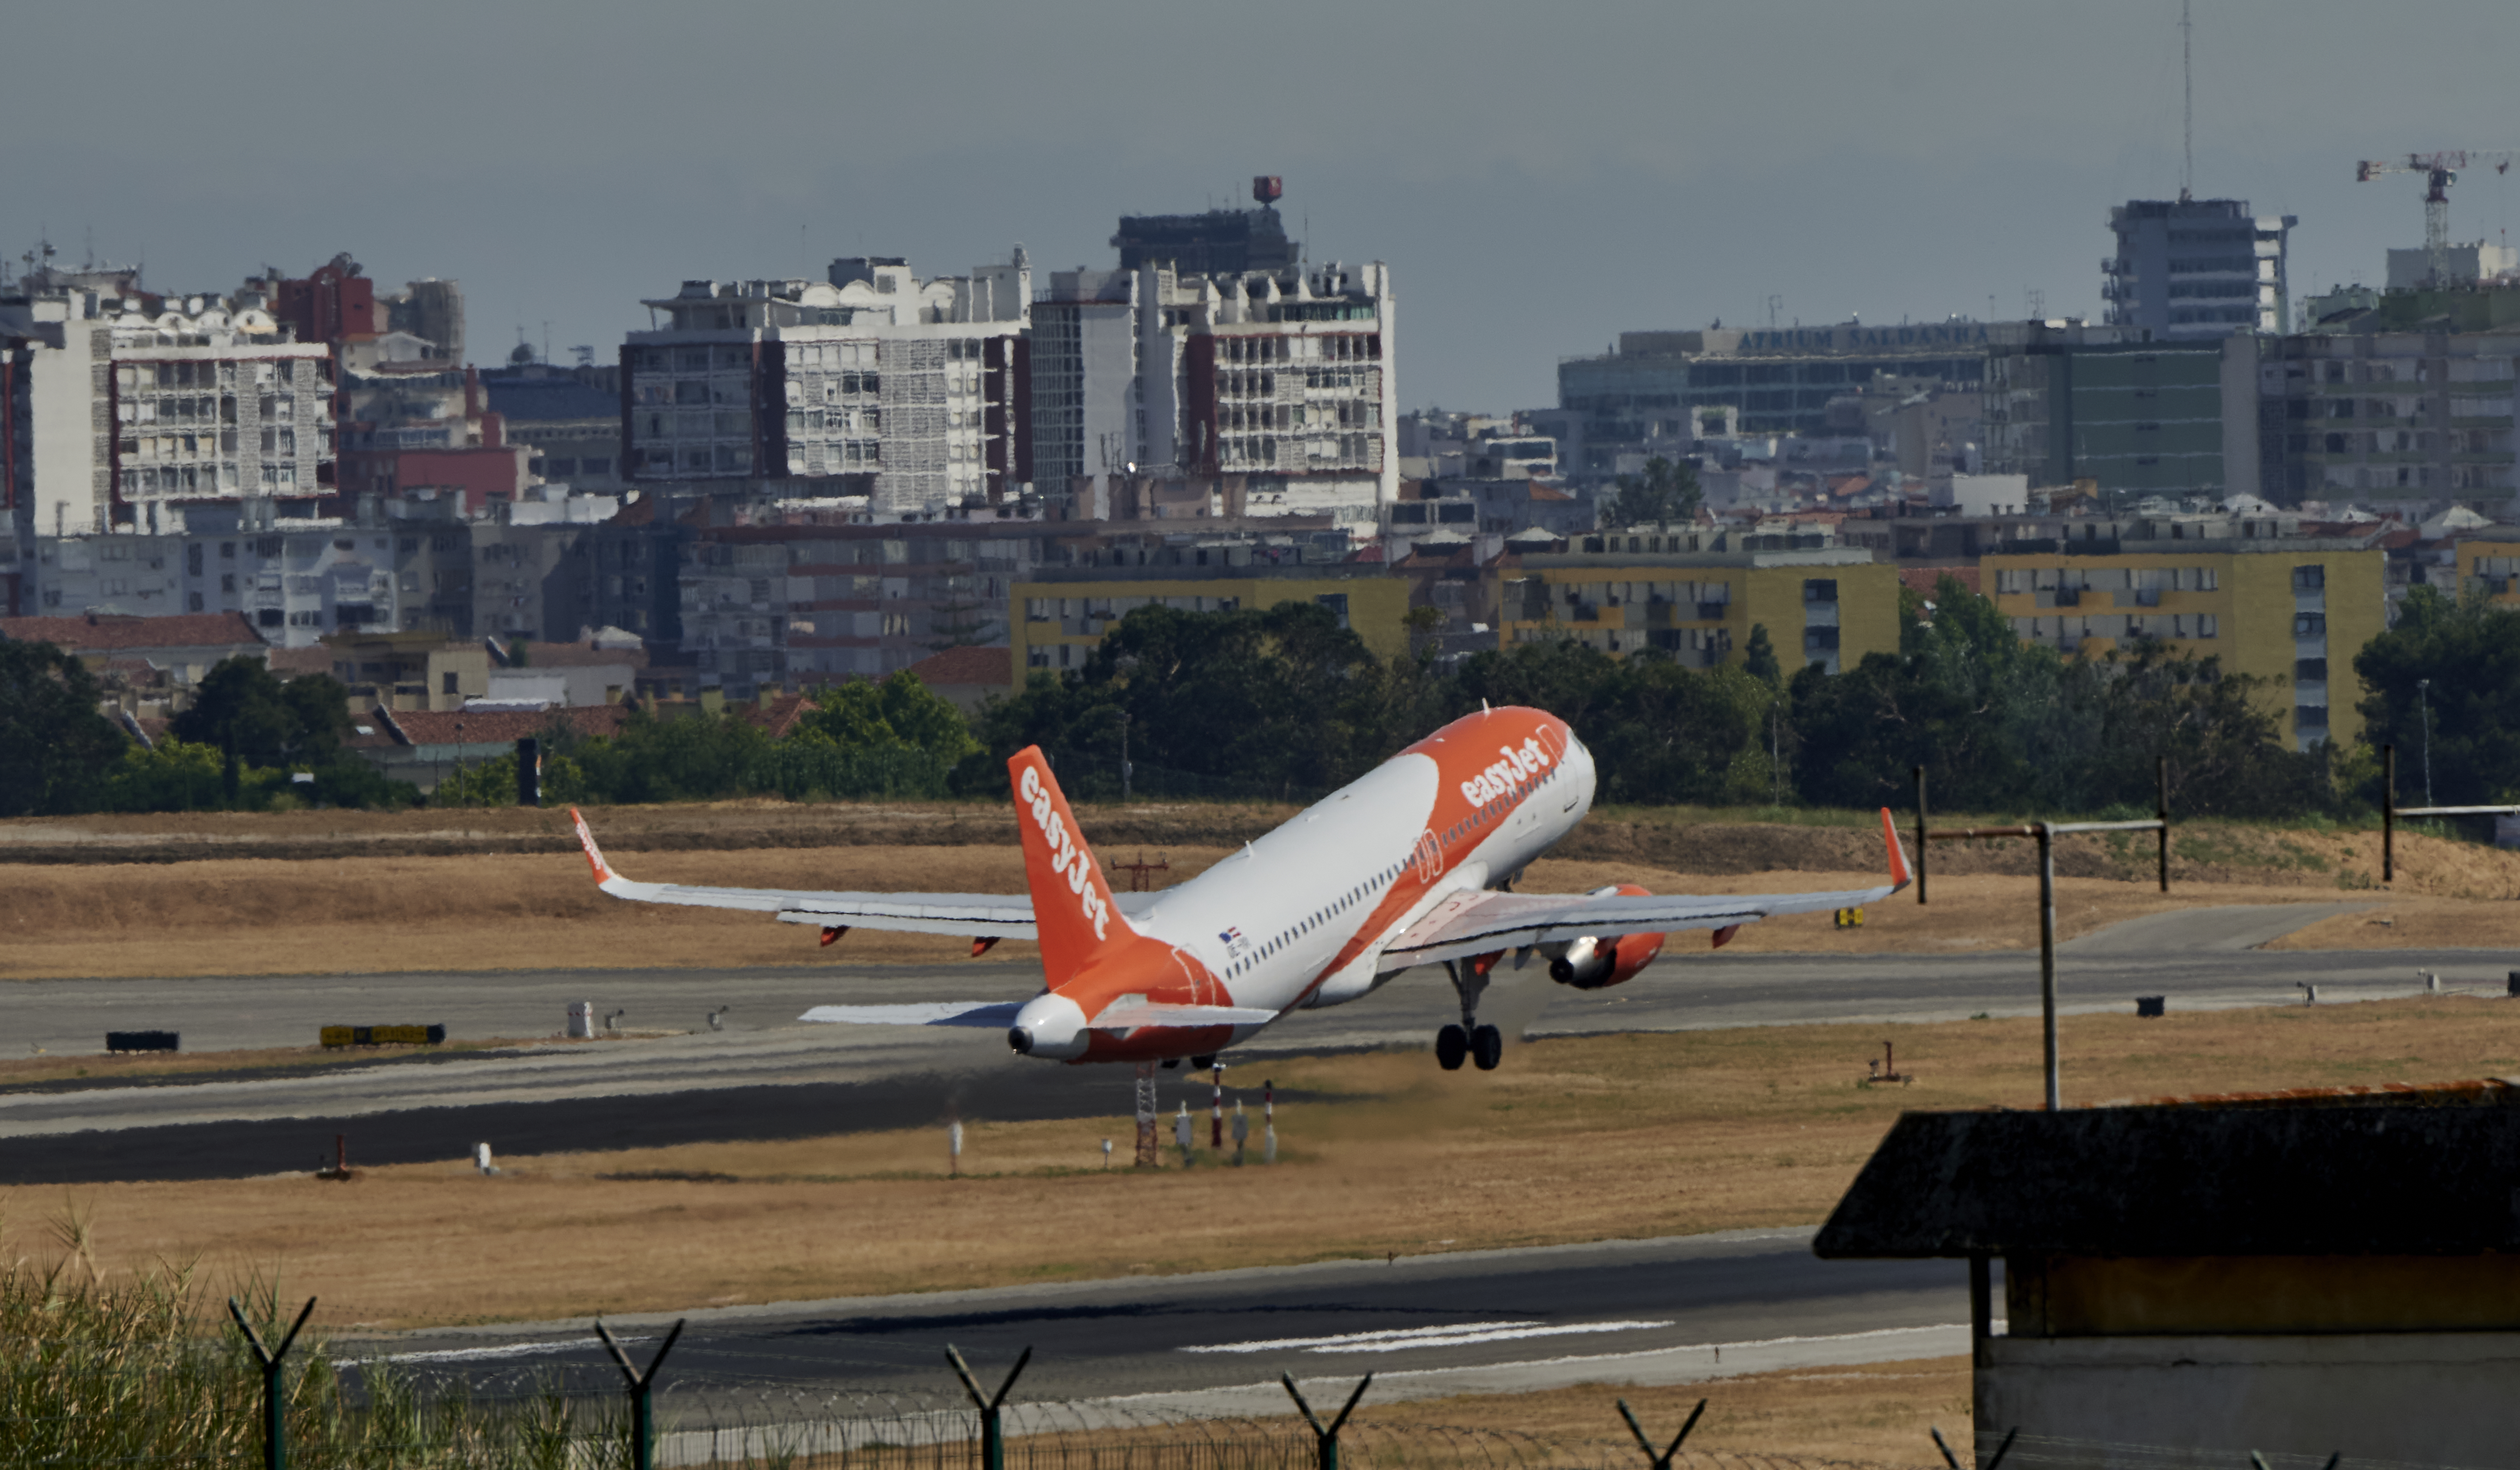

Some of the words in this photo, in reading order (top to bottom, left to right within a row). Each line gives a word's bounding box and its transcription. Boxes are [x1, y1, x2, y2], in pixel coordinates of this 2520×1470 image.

[1737, 330, 1833, 349] ATRIUM
[1461, 737, 1549, 808] easyJet
[1021, 766, 1109, 941] easyJet
